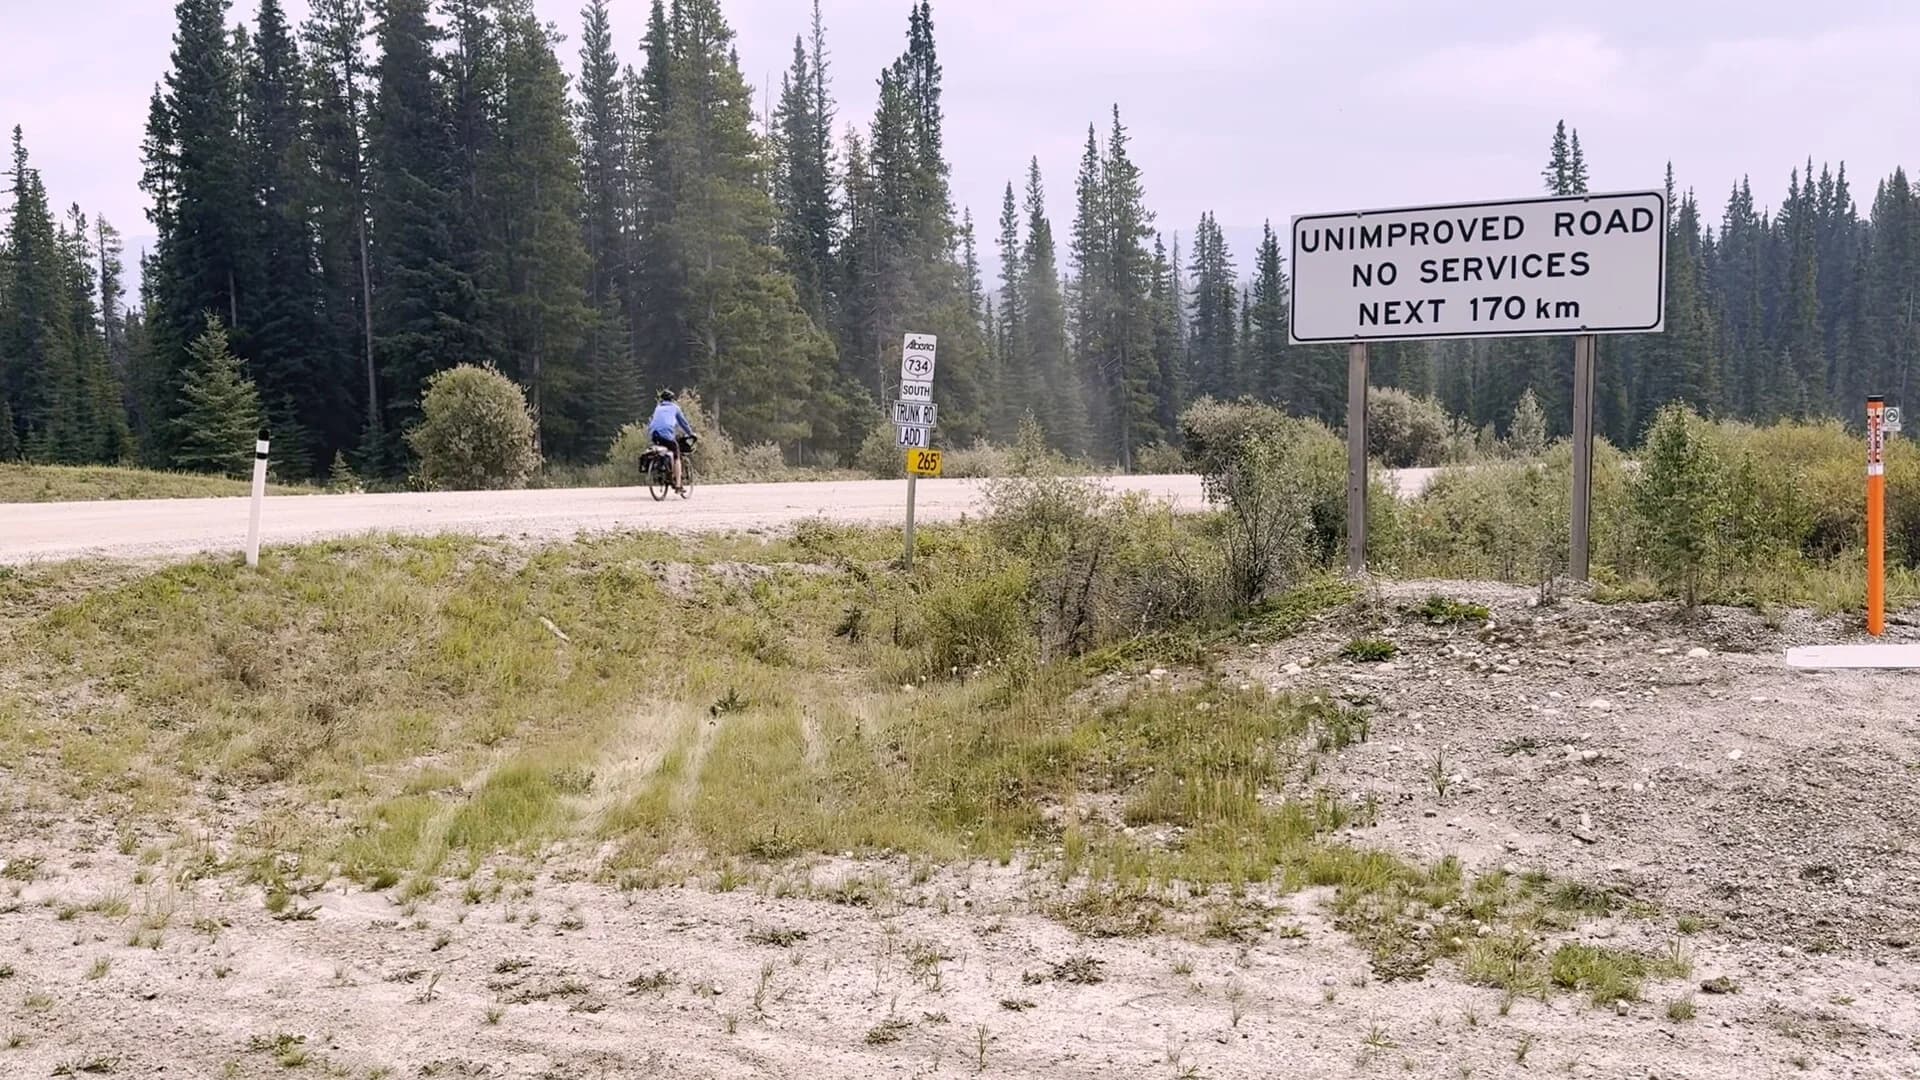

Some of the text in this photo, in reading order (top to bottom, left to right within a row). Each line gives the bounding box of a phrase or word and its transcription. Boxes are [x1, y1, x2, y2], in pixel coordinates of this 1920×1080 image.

[1300, 207, 1654, 253] UNIMPROVED ROAD
[1352, 251, 1591, 288] NO SERVICES
[1358, 296, 1580, 326] NEXT 170 km
[908, 359, 928, 373] 734
[902, 384, 930, 397] SOUTH
[897, 404, 934, 424] TRUNK RD
